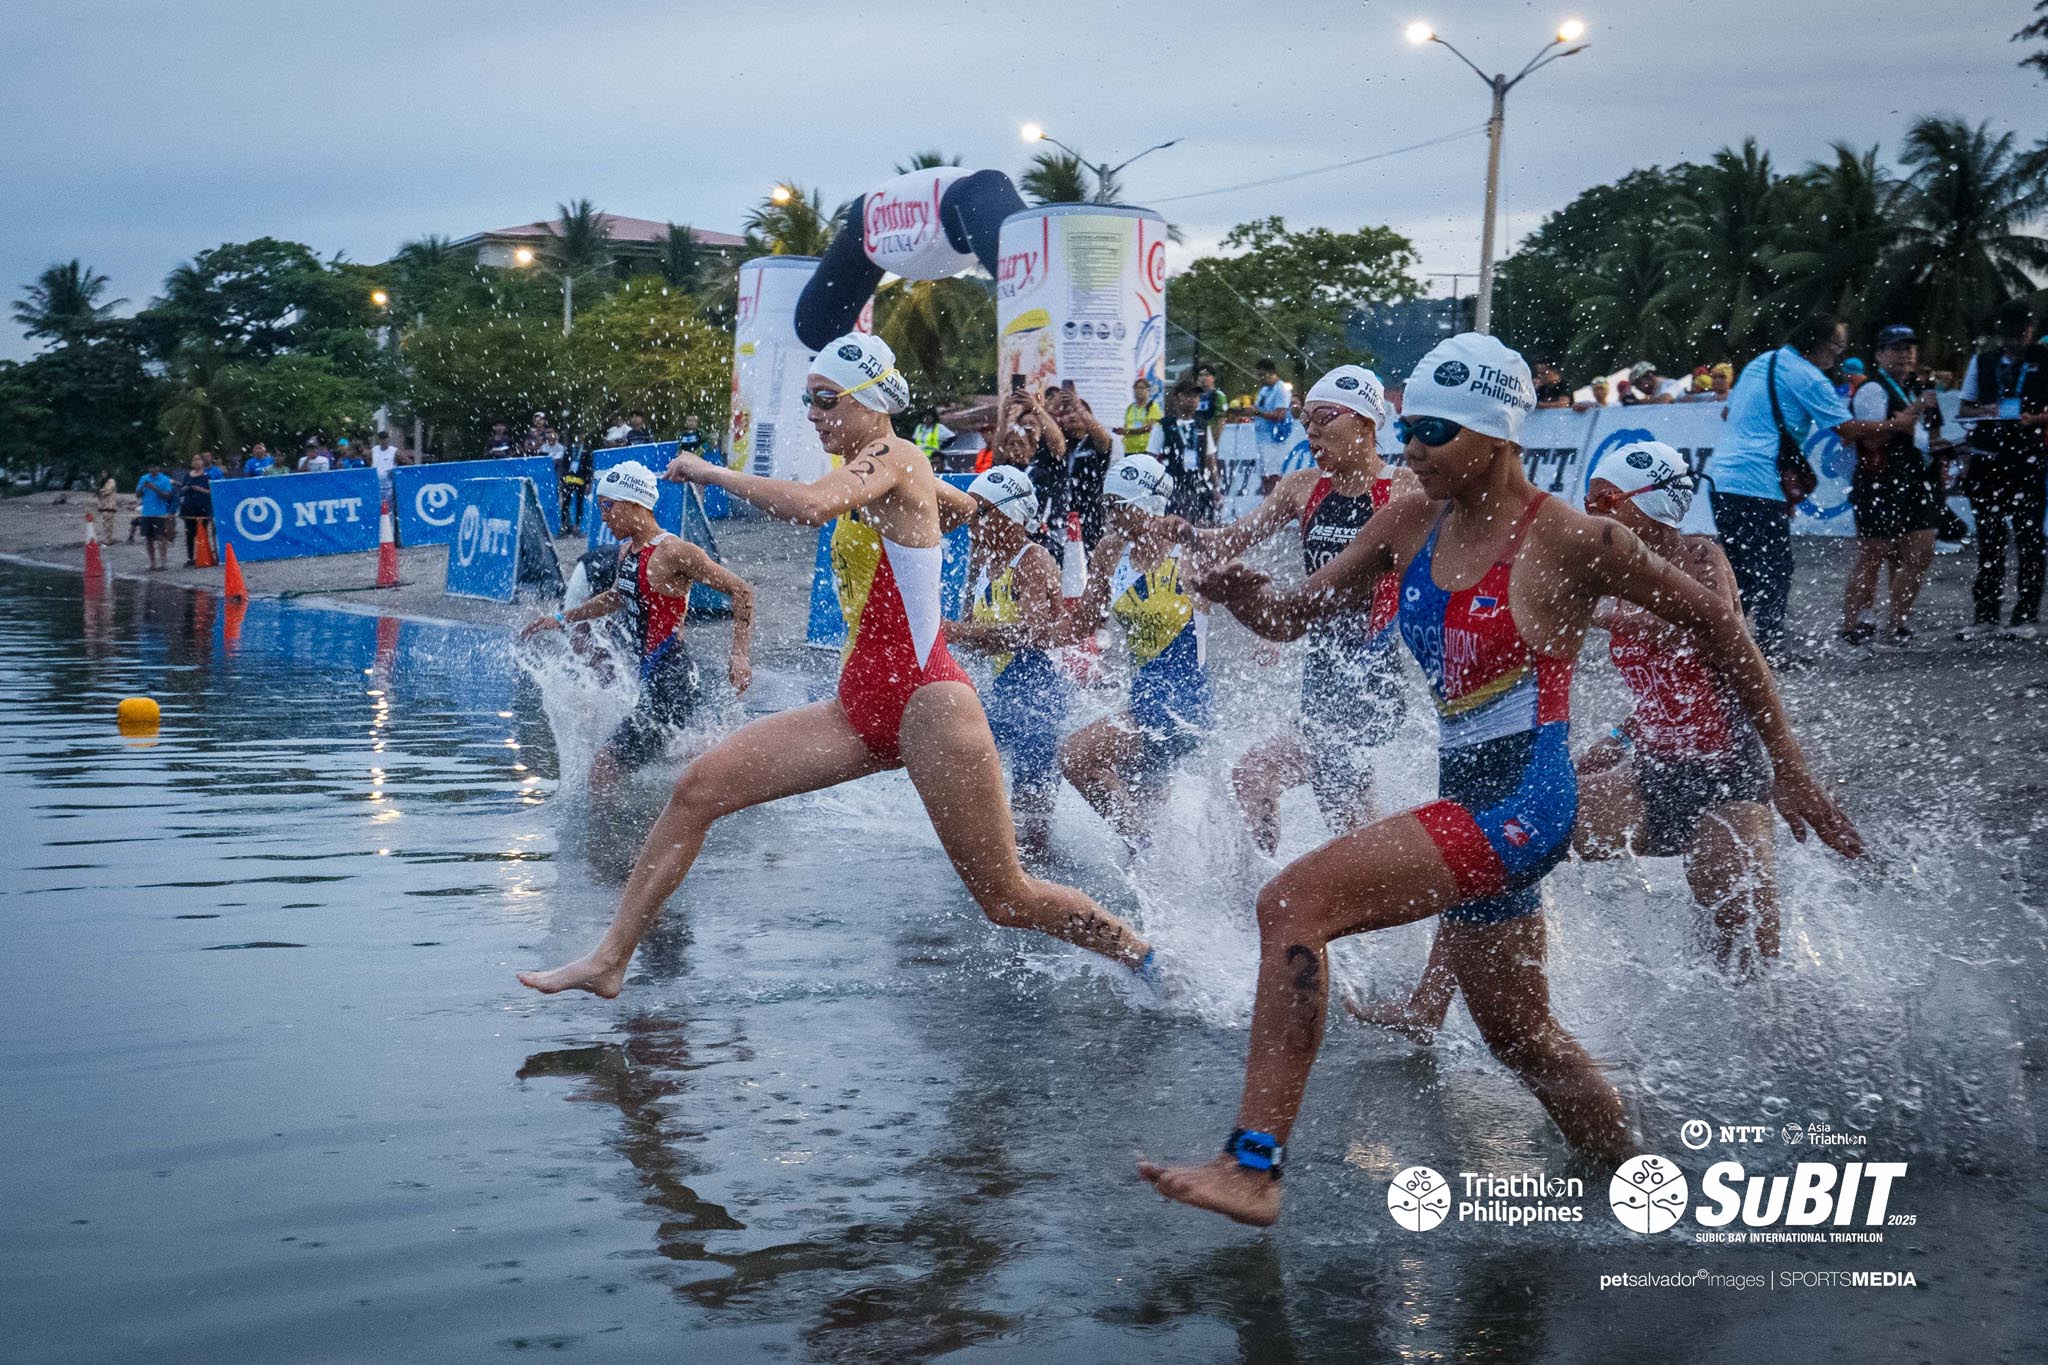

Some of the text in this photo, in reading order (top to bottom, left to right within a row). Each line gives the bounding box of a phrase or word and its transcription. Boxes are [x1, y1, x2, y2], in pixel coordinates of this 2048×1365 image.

[864, 192, 929, 253] Century
[293, 497, 362, 527] NTT
[480, 517, 512, 556] NTT
